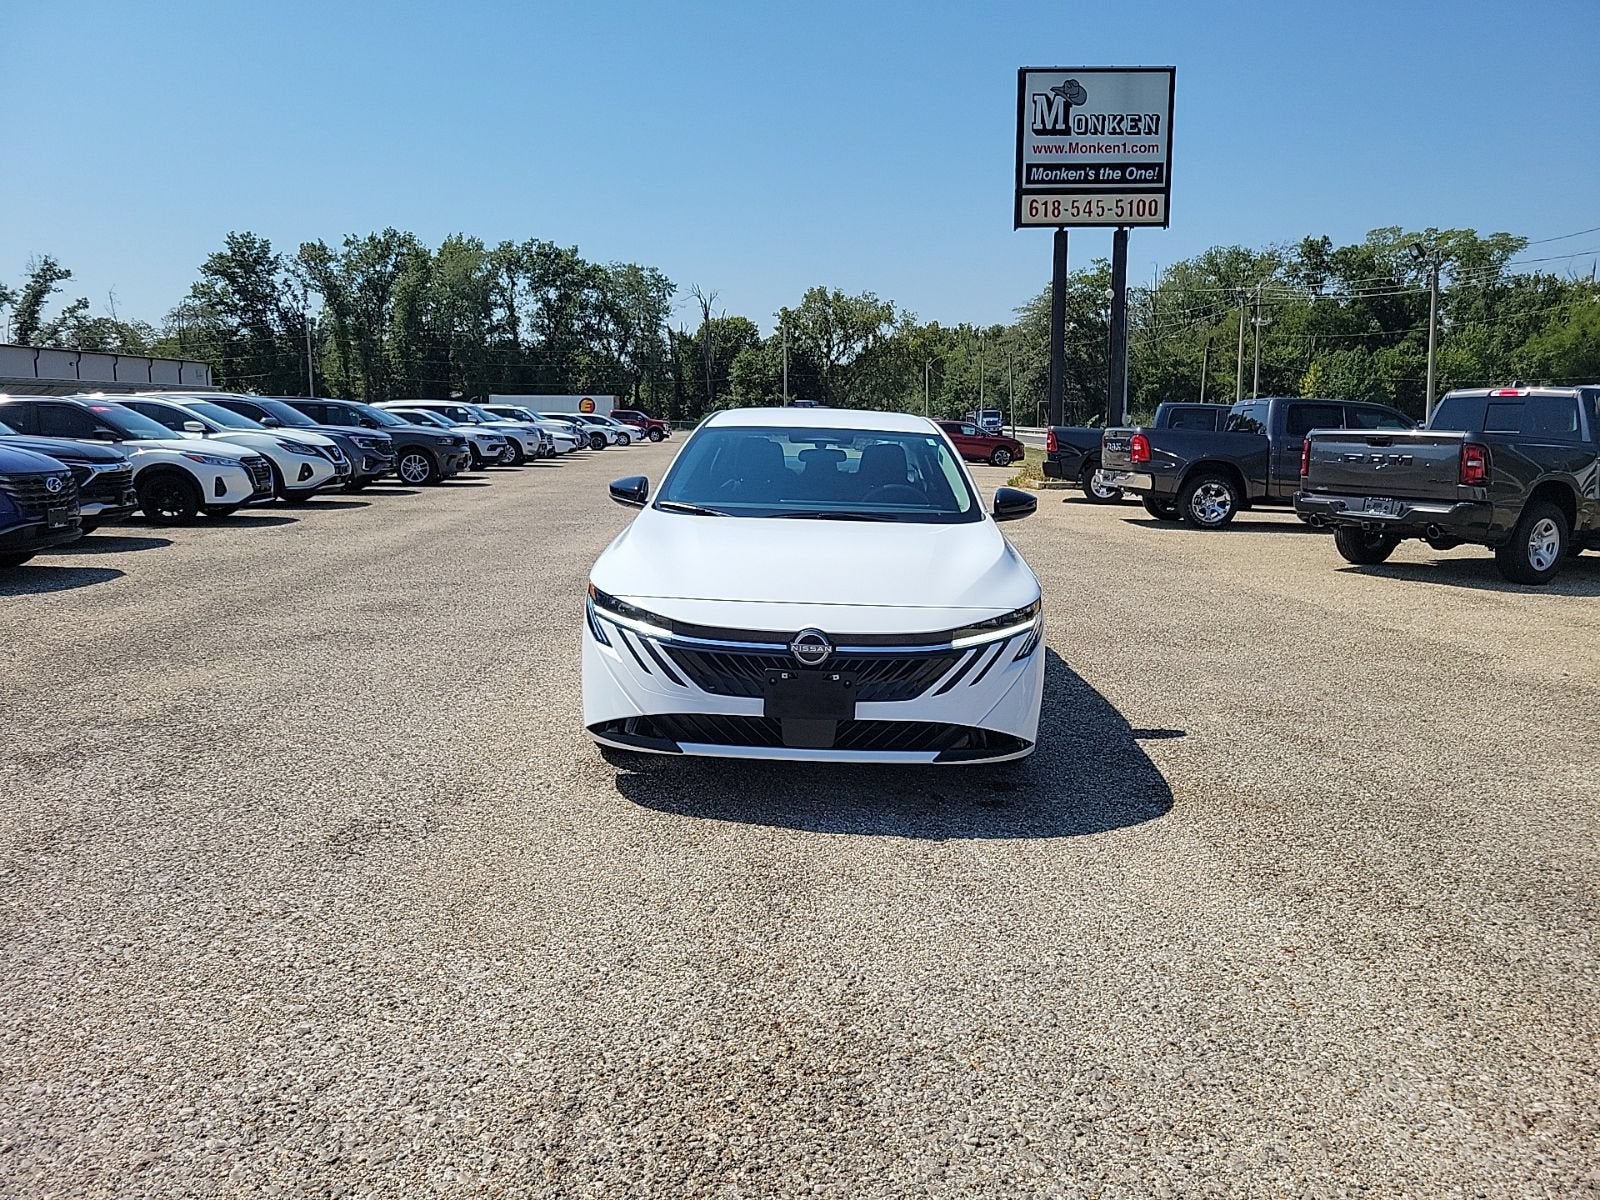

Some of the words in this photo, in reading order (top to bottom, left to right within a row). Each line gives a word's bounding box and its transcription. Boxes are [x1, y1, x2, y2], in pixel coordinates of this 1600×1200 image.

[1032, 93, 1160, 135] MONKEN
[1032, 142, 1159, 154] www.Monken1.com
[1030, 167, 1095, 181] Monken's
[1100, 167, 1121, 180] the
[1125, 167, 1159, 180] One!
[1029, 198, 1158, 218] 618-545-5100
[1343, 453, 1413, 466] RAM
[790, 644, 832, 652] NISSAN
